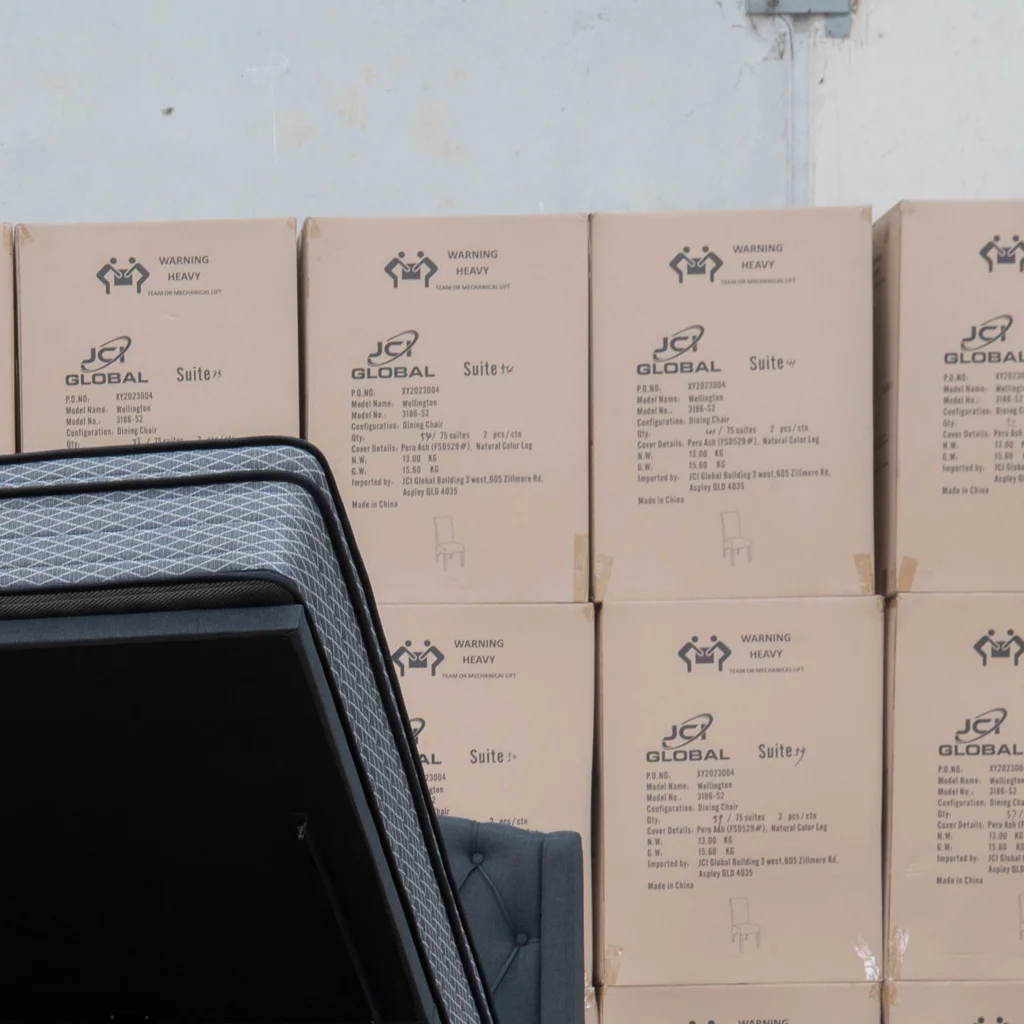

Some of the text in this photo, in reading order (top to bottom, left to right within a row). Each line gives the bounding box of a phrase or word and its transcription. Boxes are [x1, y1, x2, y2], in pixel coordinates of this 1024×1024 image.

[733, 244, 784, 254] WARNING
[159, 255, 209, 265] WARNING
[447, 250, 498, 260] WARNING
[741, 259, 775, 269] HEAVY
[456, 265, 490, 275] HEAVY
[168, 271, 201, 281] HEAVY
[961, 320, 1009, 346] JCI
[367, 336, 414, 361] JCI
[653, 331, 700, 356] JCI
[81, 342, 128, 367] JCI
[636, 361, 721, 375] GLOBAL
[749, 355, 784, 371] Suite
[351, 366, 435, 380] GLOBAL
[463, 361, 497, 376] Suite
[65, 372, 149, 386] GLOBAL
[176, 366, 210, 382] Suite
[402, 399, 437, 408] Wellington
[116, 405, 151, 414] Wellington
[402, 421, 443, 430] Dining Chair
[476, 442, 533, 451] Natural Color Leg
[352, 500, 369, 509] Made
[379, 500, 397, 508] China
[741, 634, 792, 643] WARNING
[454, 639, 504, 649] WARNING
[750, 649, 783, 659] HEAVY
[462, 655, 495, 664] HEAVY
[955, 713, 1003, 738] JCI
[662, 719, 709, 744] JCI
[758, 743, 792, 759] Suite
[938, 743, 1023, 757] GLOBAL
[470, 748, 504, 764] Suite
[646, 749, 730, 763] GLOBAL
[697, 781, 732, 791] Wellington
[698, 803, 738, 812] Dining Chair
